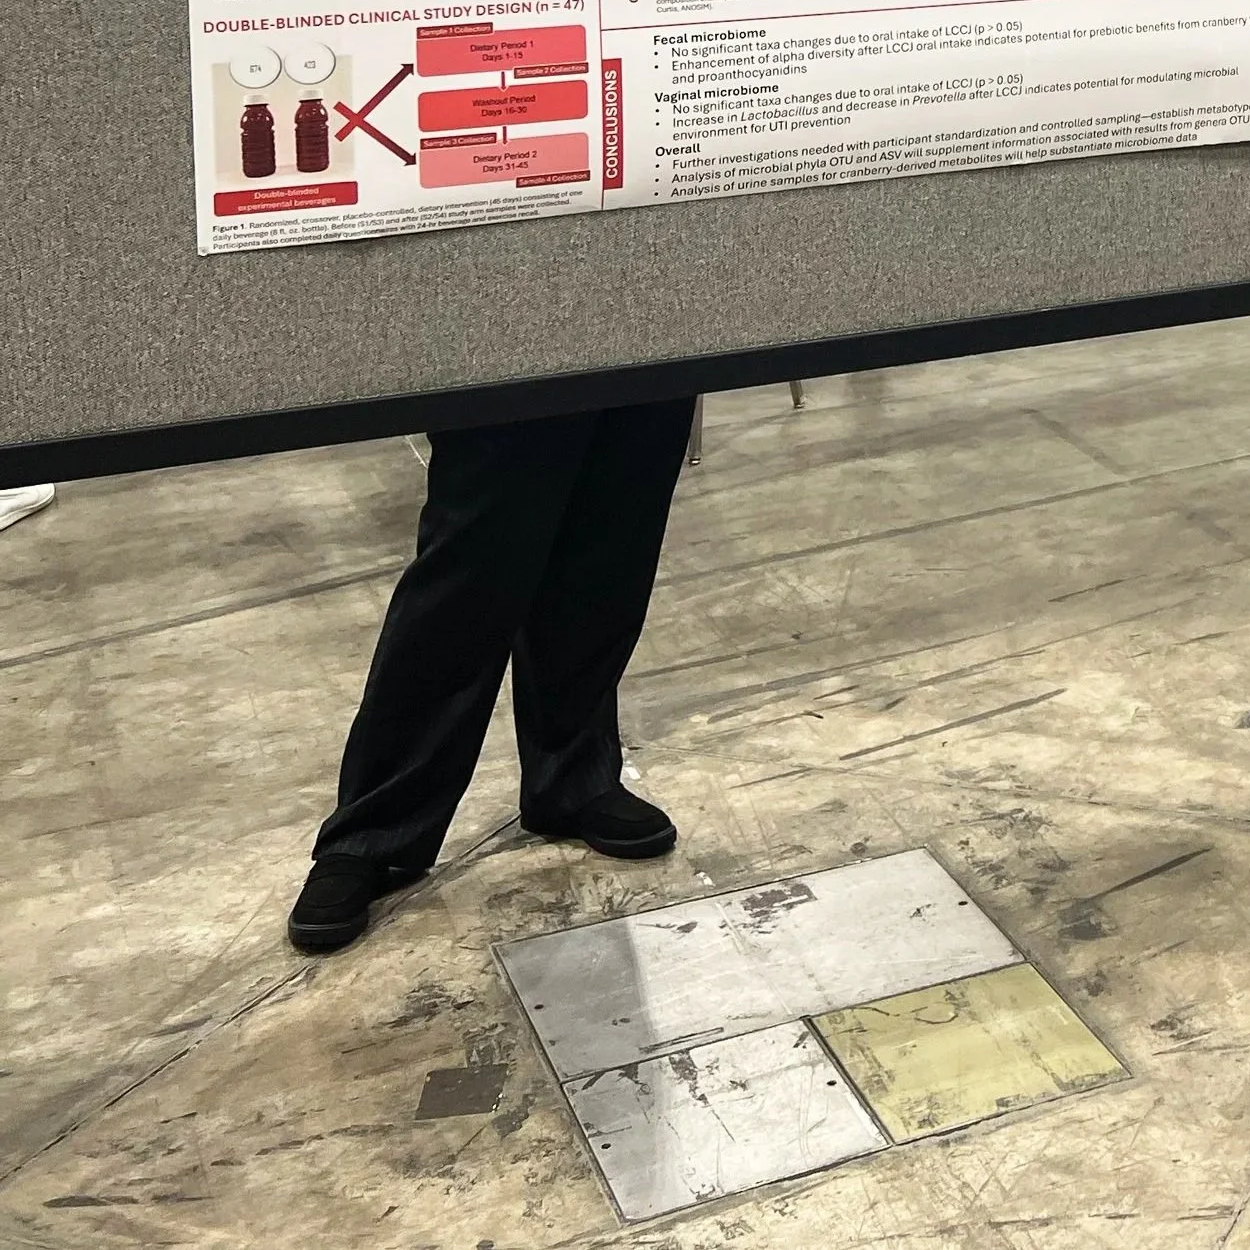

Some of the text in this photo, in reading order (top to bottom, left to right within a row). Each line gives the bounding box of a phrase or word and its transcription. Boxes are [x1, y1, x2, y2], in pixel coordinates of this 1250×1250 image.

[202, 13, 345, 33] DOUBLE-BLINDED
[348, 9, 420, 24] CLINICAL
[423, 5, 472, 20] STUDY
[475, 1, 532, 16] DESIGN
[535, 0, 548, 14] (n
[652, 29, 766, 45] Fecal microbiome
[653, 84, 779, 104] Vaginal microbiome
[604, 69, 618, 178] CONCLUSIONS
[654, 142, 701, 157] Overall
